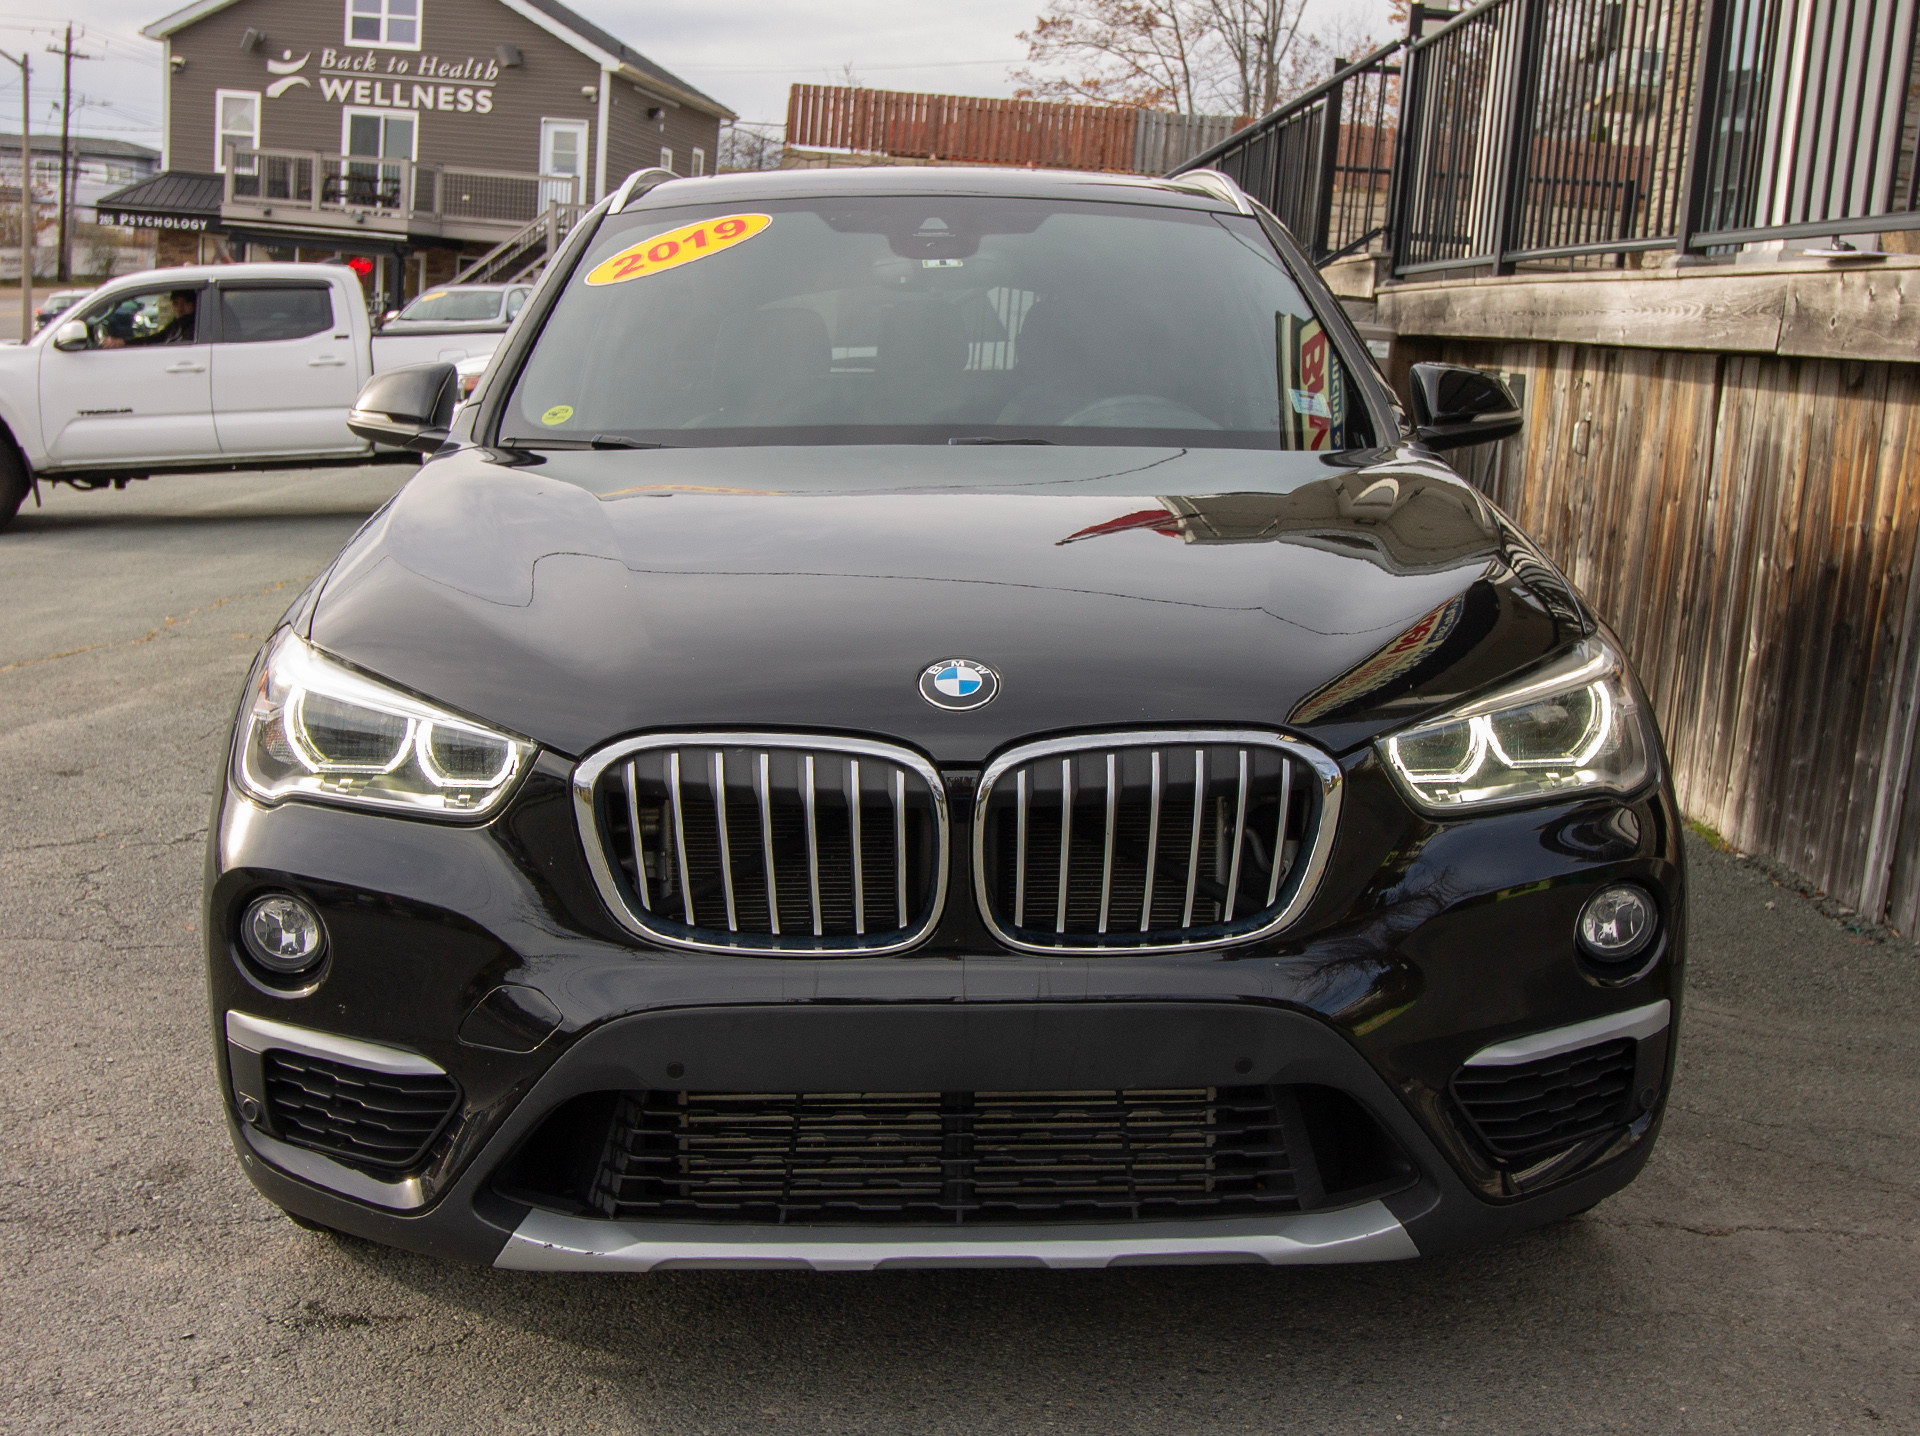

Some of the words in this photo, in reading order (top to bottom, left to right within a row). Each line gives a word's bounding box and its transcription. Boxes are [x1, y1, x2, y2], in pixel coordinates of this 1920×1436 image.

[321, 48, 377, 72] Back
[387, 56, 409, 74] to
[418, 56, 499, 80] Health
[319, 78, 493, 113] WELLNESS
[120, 213, 207, 230] PSYCHOLOGY
[612, 218, 748, 280] 2019
[928, 660, 990, 675] BMW
